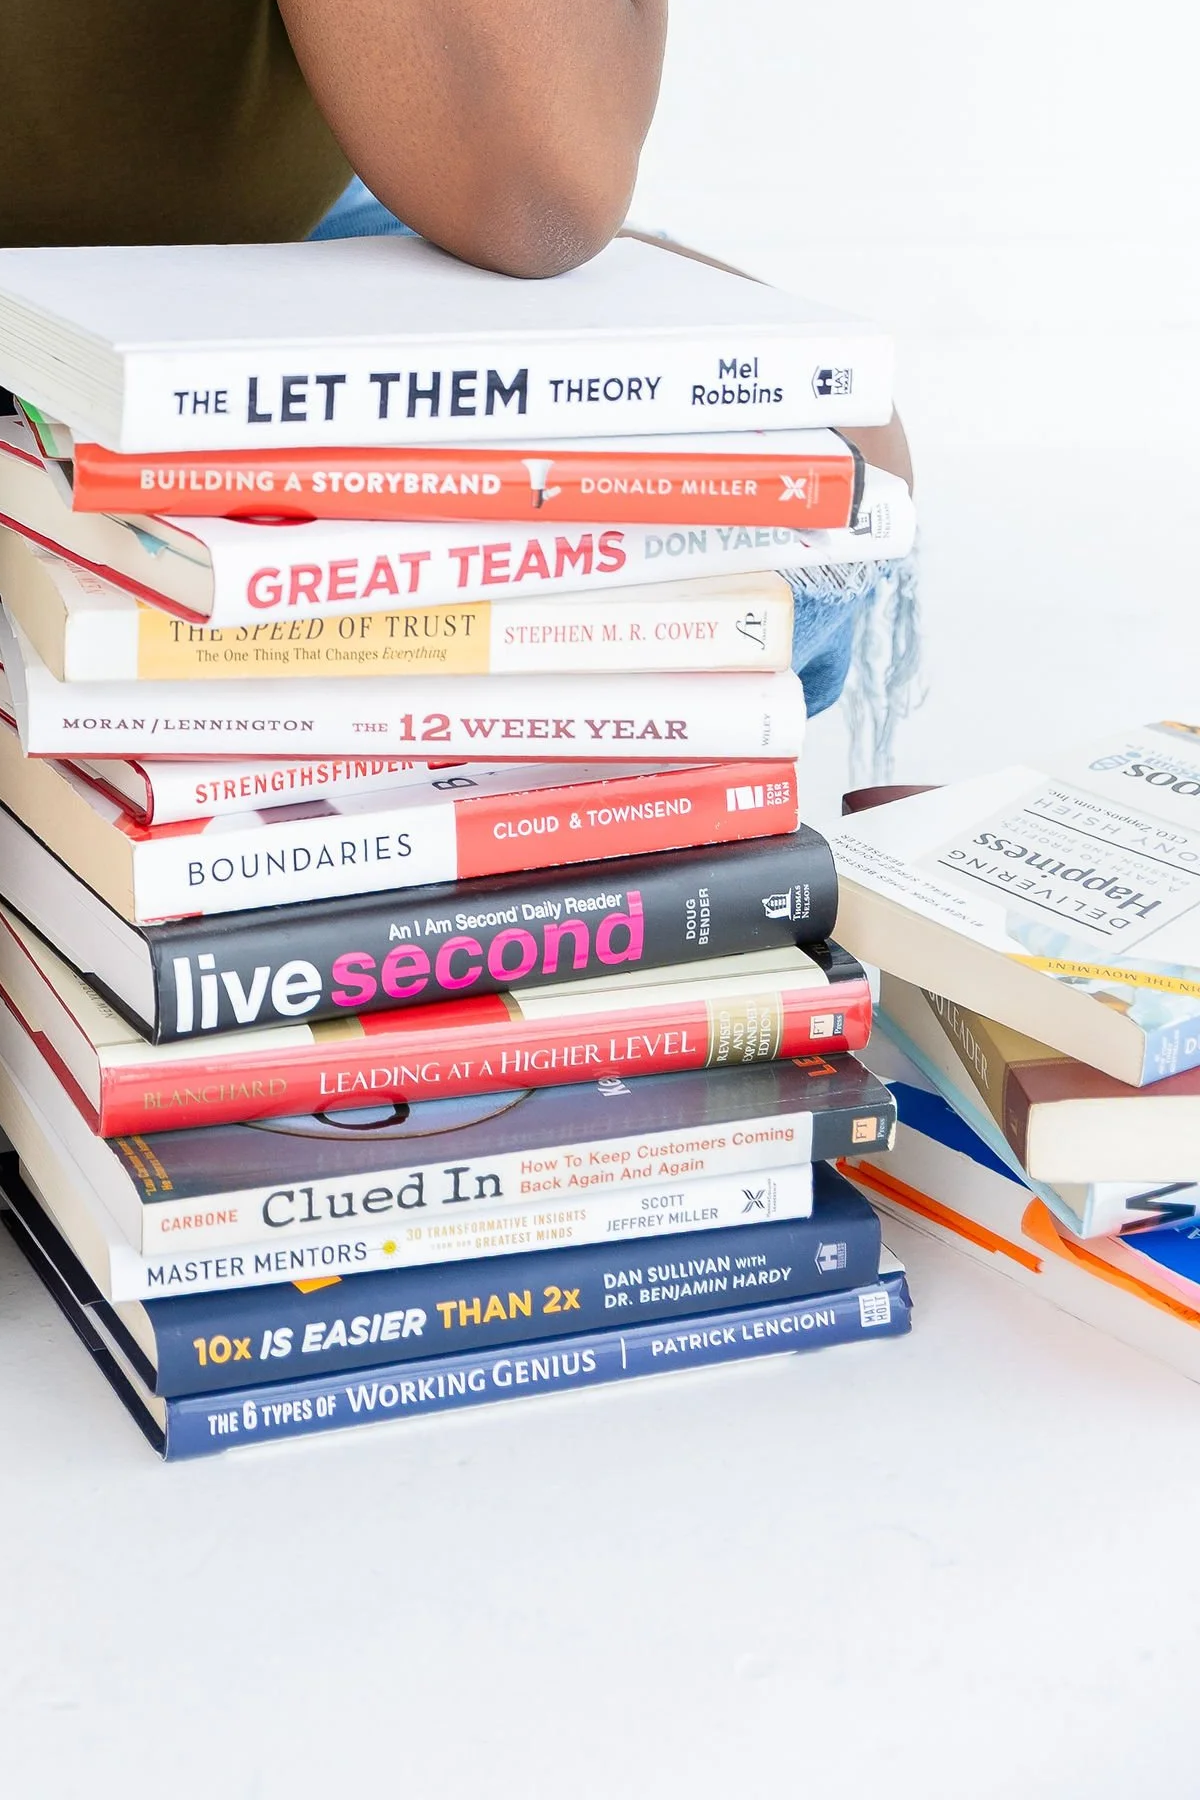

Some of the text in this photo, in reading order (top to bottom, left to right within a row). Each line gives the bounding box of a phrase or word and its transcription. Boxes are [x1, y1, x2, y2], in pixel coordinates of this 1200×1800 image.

[719, 357, 758, 379] Mel
[174, 368, 661, 423] THE LET THEM THEORY
[692, 384, 783, 406] Robbins
[140, 469, 757, 496] BUILDING STORYBRAND DONALD MILLER
[246, 530, 706, 610] GREAT TEAMS DON
[504, 621, 719, 645] STEPHEN COVEY
[196, 646, 447, 664] The One Thing That Changes Everything
[353, 714, 688, 741] THE 12 WEEK YEAR
[761, 713, 771, 746] WILEY
[766, 784, 775, 806] ZON
[493, 798, 692, 839] CLOUD & TOWNSEND
[1034, 798, 1121, 834] HSIEH
[188, 833, 412, 886] BOUNDARIES
[972, 832, 1162, 919] Happiness
[523, 892, 623, 920] Daily Reader
[947, 849, 1132, 929] DELIVERING
[686, 899, 697, 940] DOUG
[699, 888, 711, 945] BENDER
[1048, 961, 1138, 982] MOVEMENT
[717, 1011, 730, 1062] REVISED
[734, 1022, 744, 1050] AND
[759, 1007, 771, 1056] EDITION
[948, 1001, 990, 1089] LEADER
[143, 1063, 474, 1111] BLANCHARD AT
[520, 1126, 795, 1175] How To Keep Customers Coming
[520, 1158, 704, 1195] Back Again And Again
[263, 1166, 503, 1229] Clued In
[641, 1195, 685, 1210] SCOTT
[161, 1210, 238, 1233] CARBONE
[406, 1209, 587, 1242] 30 TRANSFORMATIVE INSIGHTS
[476, 1234, 531, 1249] GREATEST
[536, 1227, 573, 1242] MINDS
[606, 1208, 719, 1232] JEFFREY MILLER
[148, 1241, 368, 1287] MASTER MENTORS
[603, 1254, 767, 1290] DAN SULLIVAN WITH
[604, 1267, 792, 1309] DR. BENJAMIN HARDY
[876, 1296, 887, 1322] HOLT
[193, 1292, 532, 1367] 10x EASIER THAN
[208, 1309, 836, 1436] THE 6 TYPES PATRICK LENCIONI
